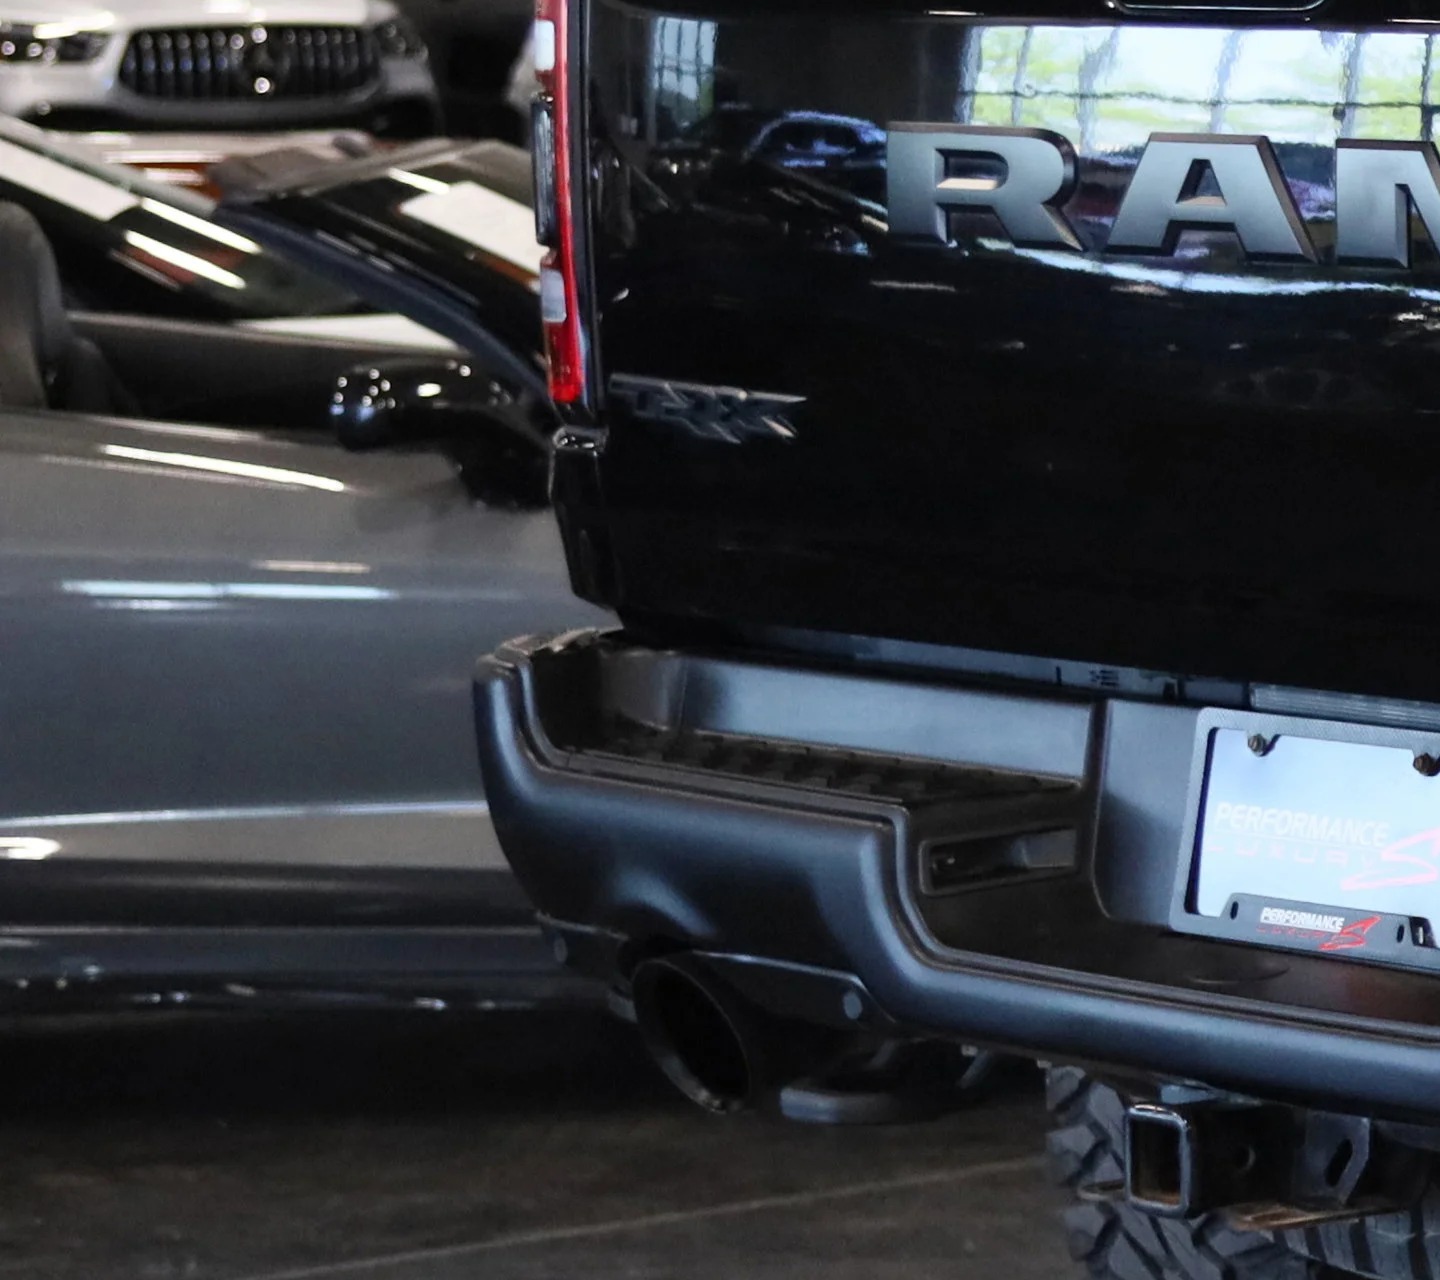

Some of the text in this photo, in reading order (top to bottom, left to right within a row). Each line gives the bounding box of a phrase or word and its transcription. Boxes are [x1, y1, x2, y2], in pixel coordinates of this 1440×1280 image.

[606, 372, 809, 445] TRX
[1212, 801, 1392, 849] PERFORMANCE
[1261, 906, 1345, 932] PERFORMANCE
